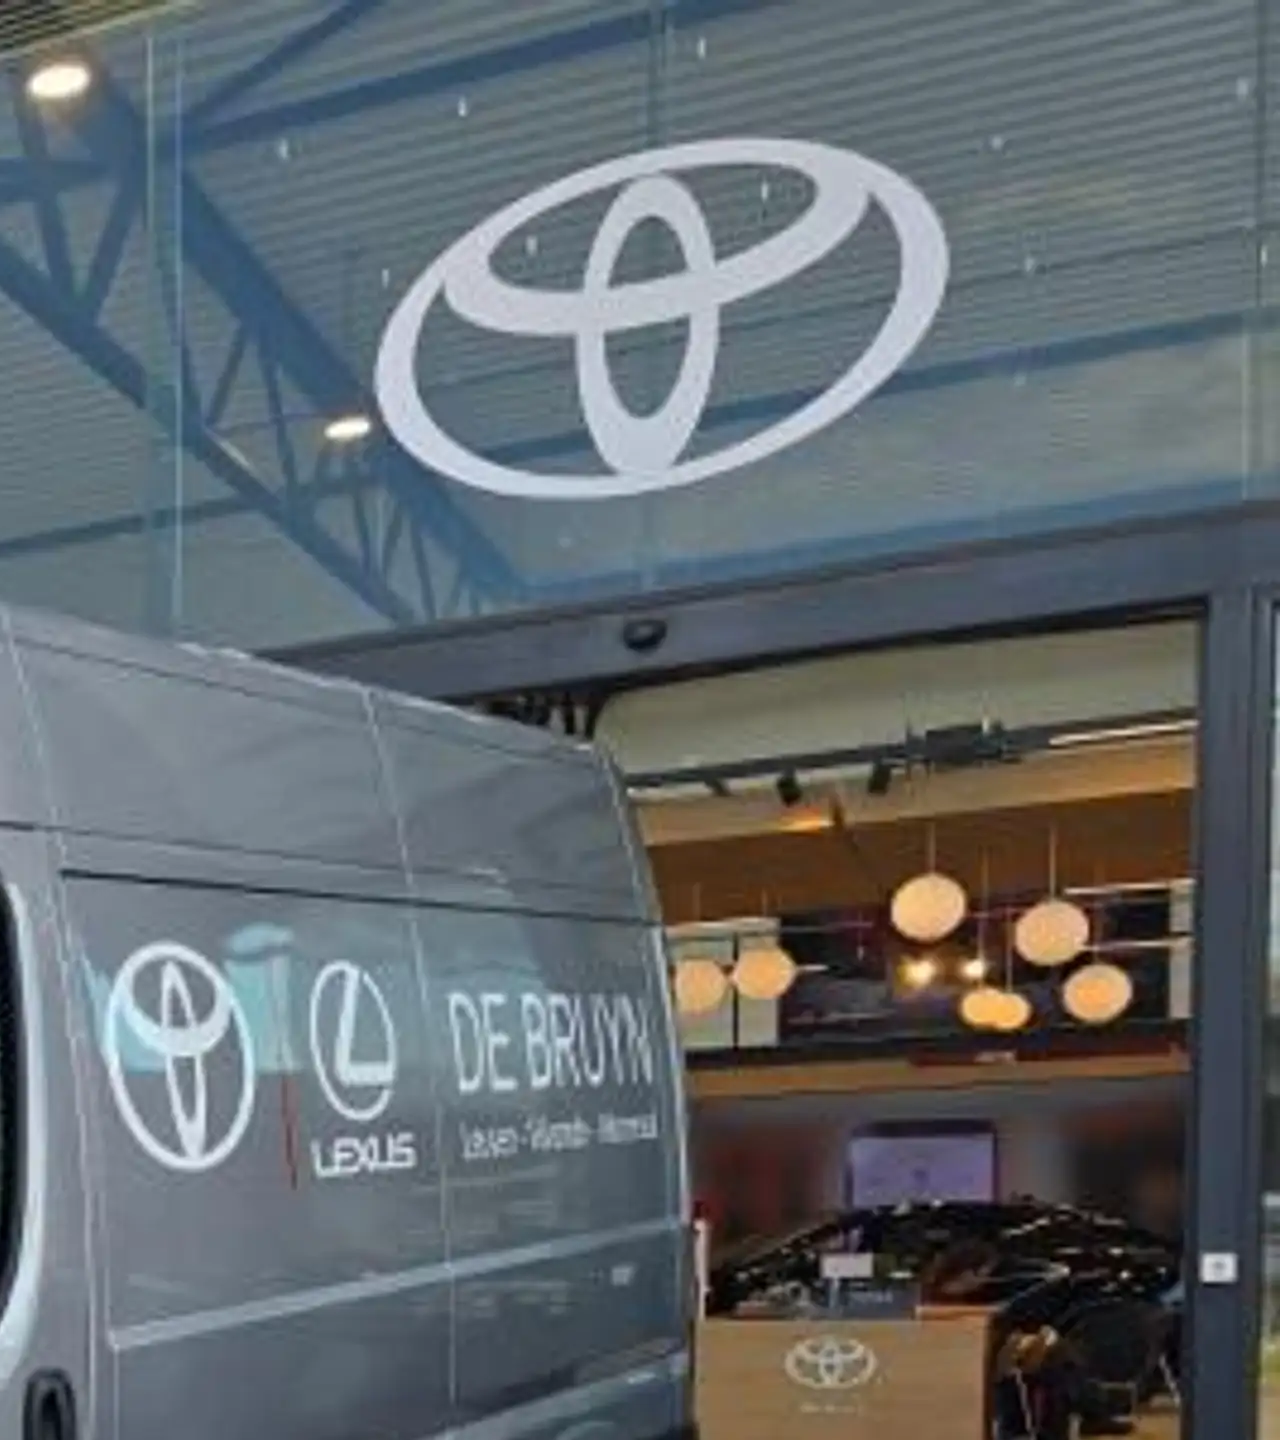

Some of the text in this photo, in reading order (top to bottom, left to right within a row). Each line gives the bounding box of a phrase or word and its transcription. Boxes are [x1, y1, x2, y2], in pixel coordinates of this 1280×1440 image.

[448, 988, 655, 1094] DE BRUYN
[309, 1132, 418, 1178] LEXUS
